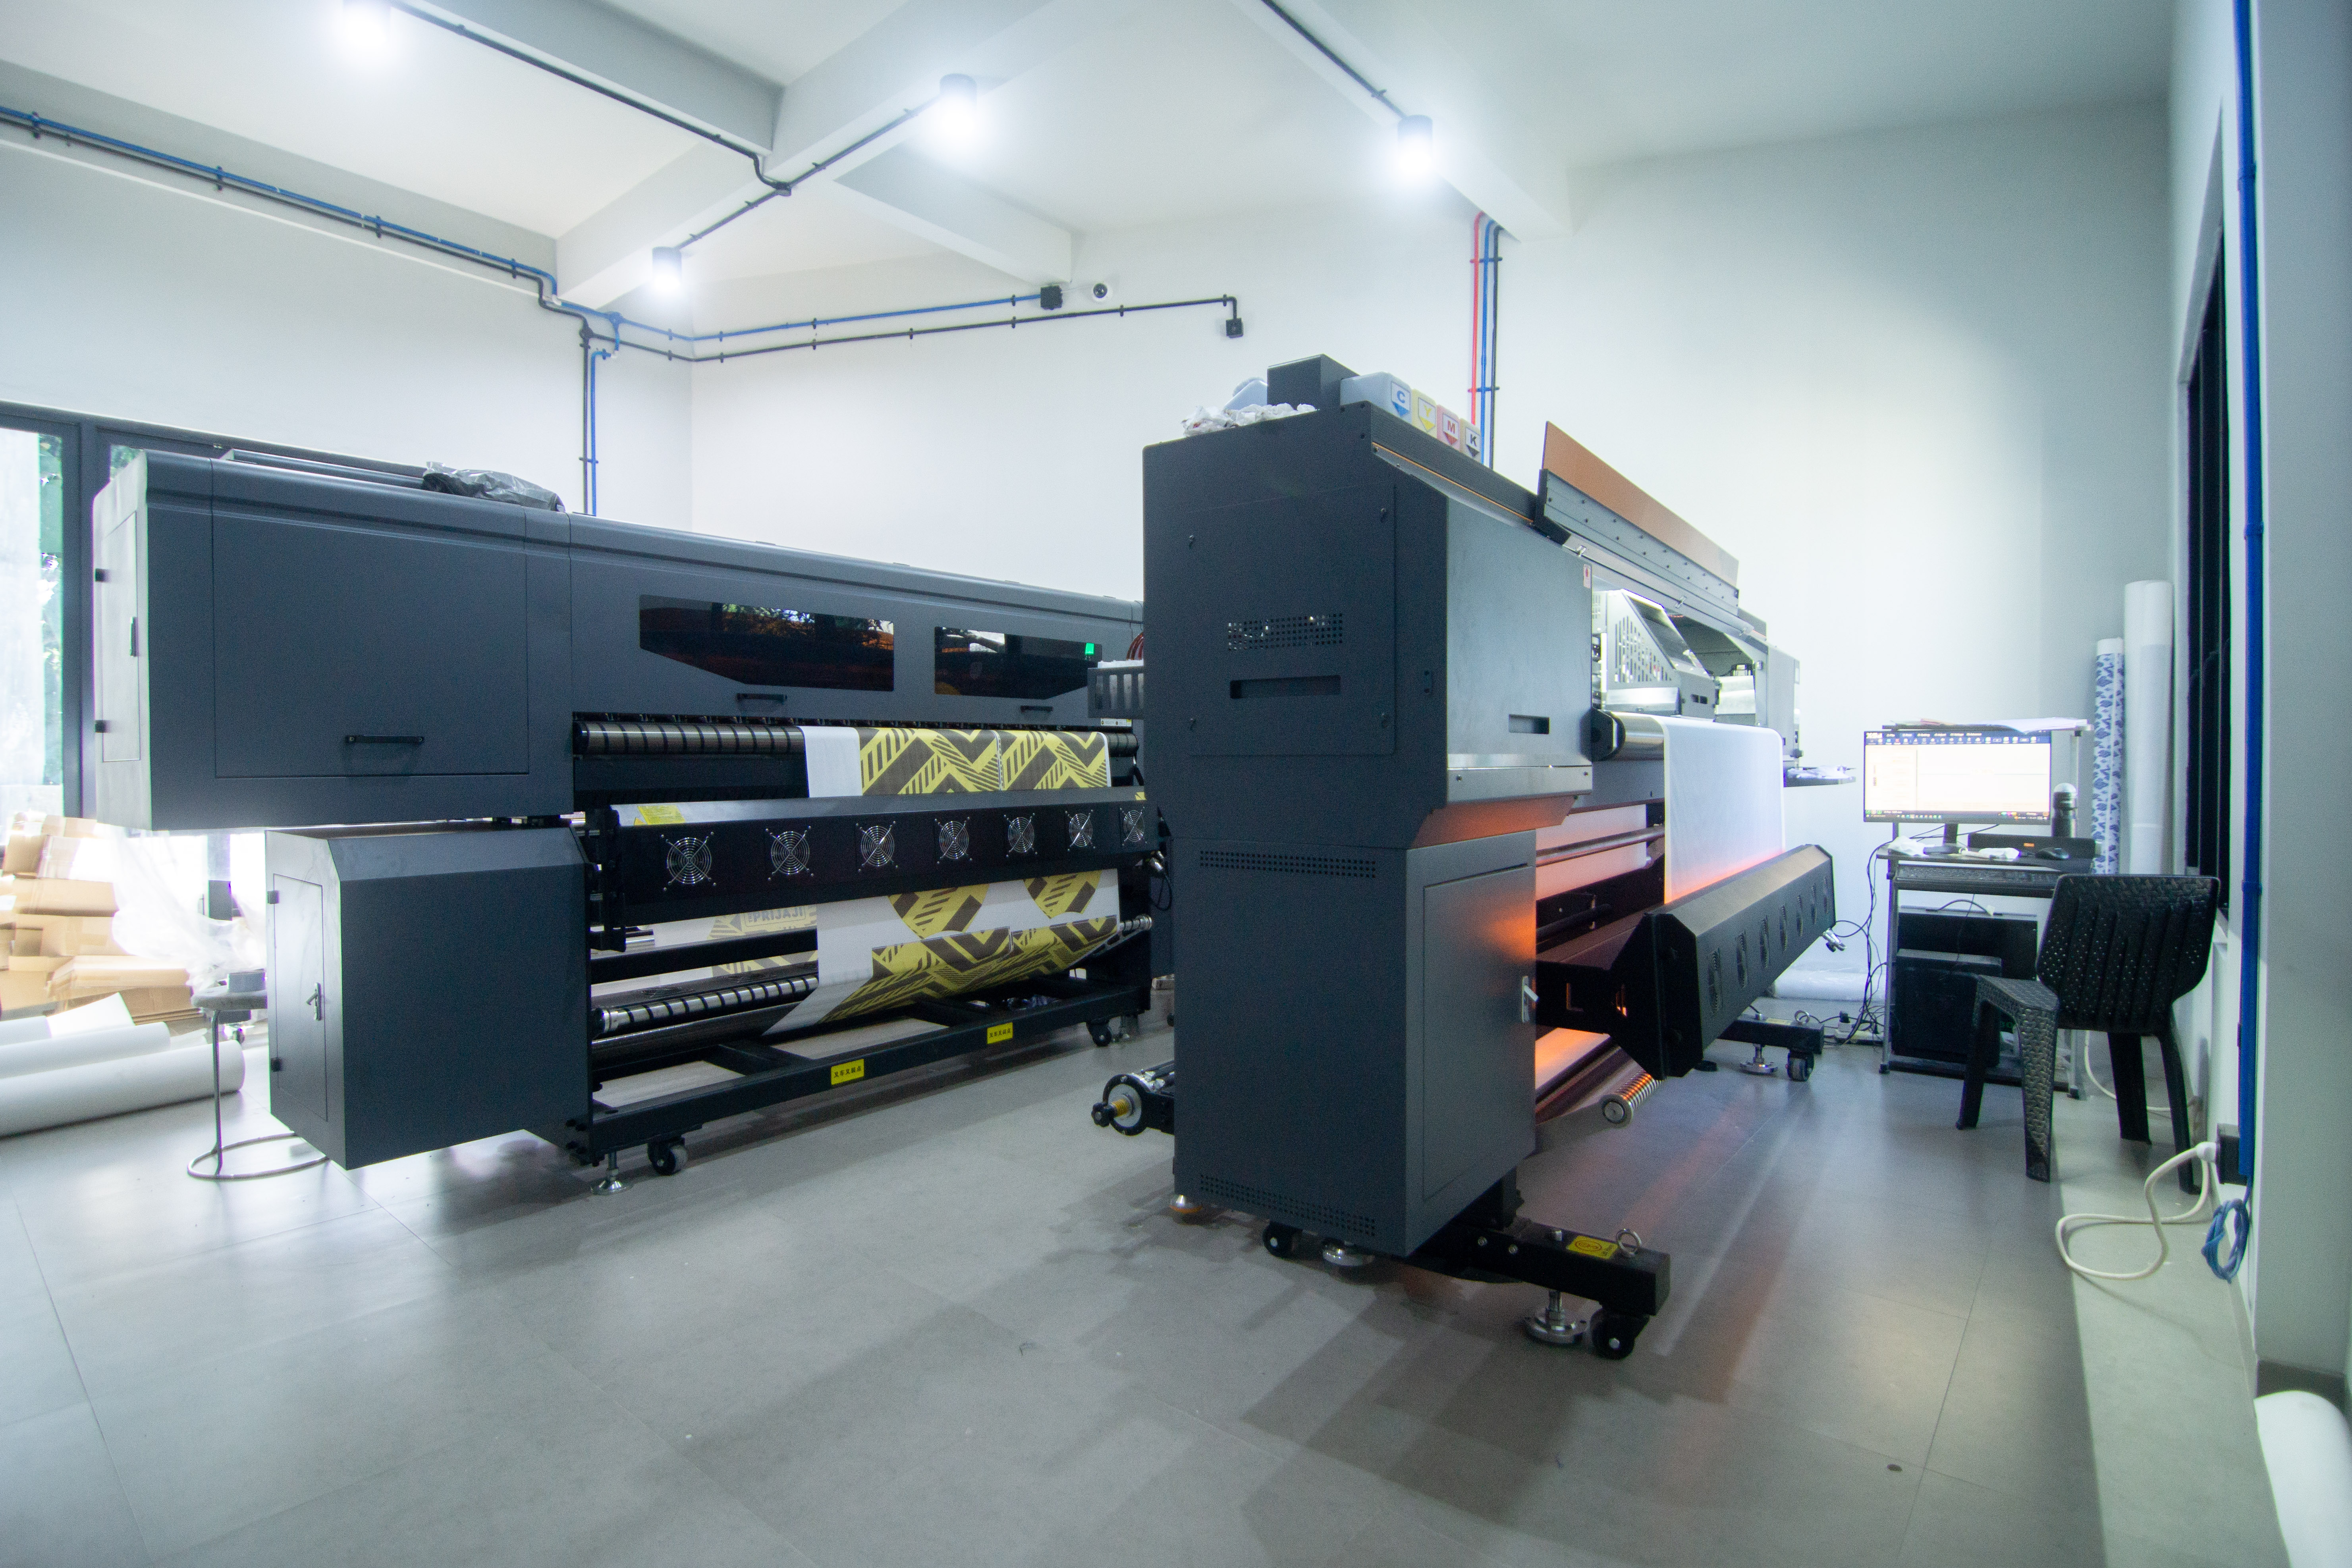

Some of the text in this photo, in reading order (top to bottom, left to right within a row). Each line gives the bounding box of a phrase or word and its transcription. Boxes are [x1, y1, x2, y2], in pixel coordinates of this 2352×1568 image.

[1397, 390, 1406, 404] C
[1424, 405, 1432, 417] Y
[1447, 420, 1456, 434] M
[1470, 434, 1477, 447] K
[753, 907, 803, 922] PRIJAJI
